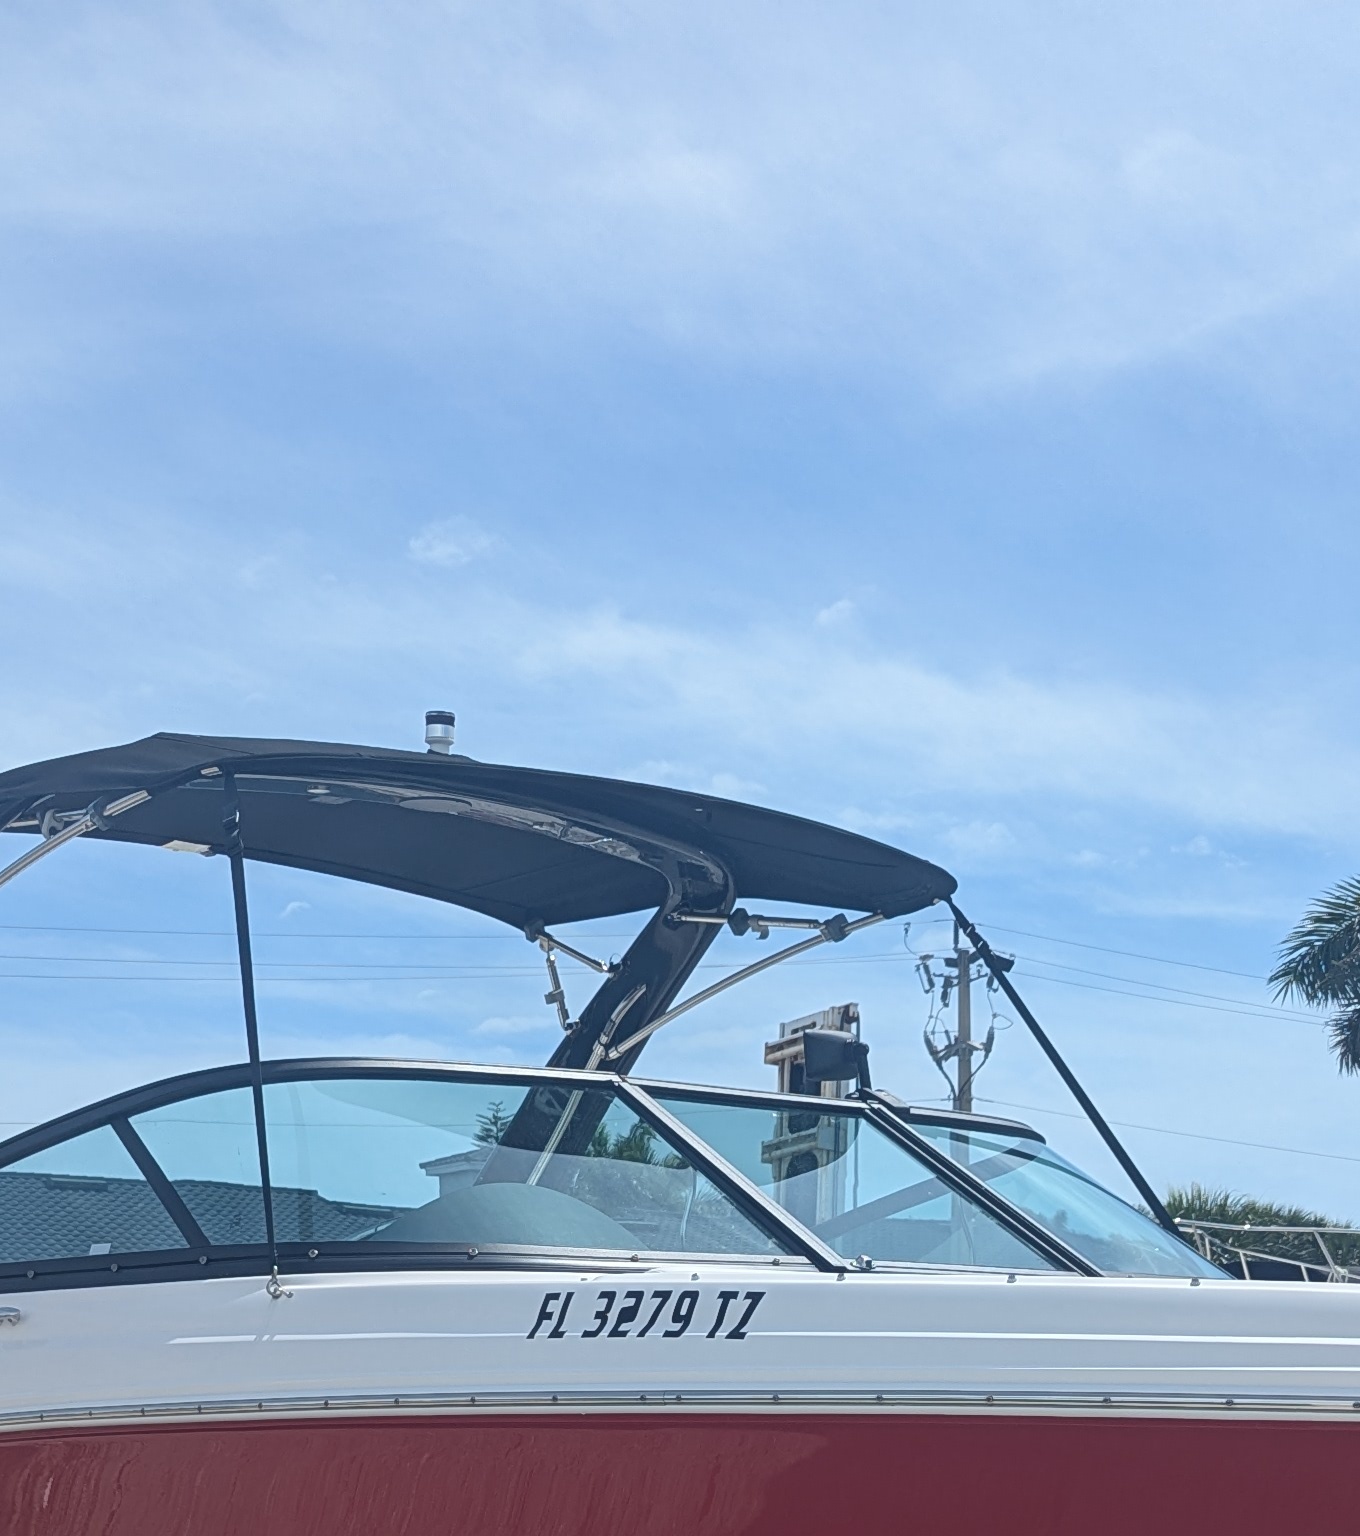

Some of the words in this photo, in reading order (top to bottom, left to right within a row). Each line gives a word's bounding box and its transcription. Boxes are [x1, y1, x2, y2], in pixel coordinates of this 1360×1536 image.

[526, 1291, 576, 1340] FL
[580, 1289, 701, 1339] 3279
[705, 1290, 767, 1340] TZ
